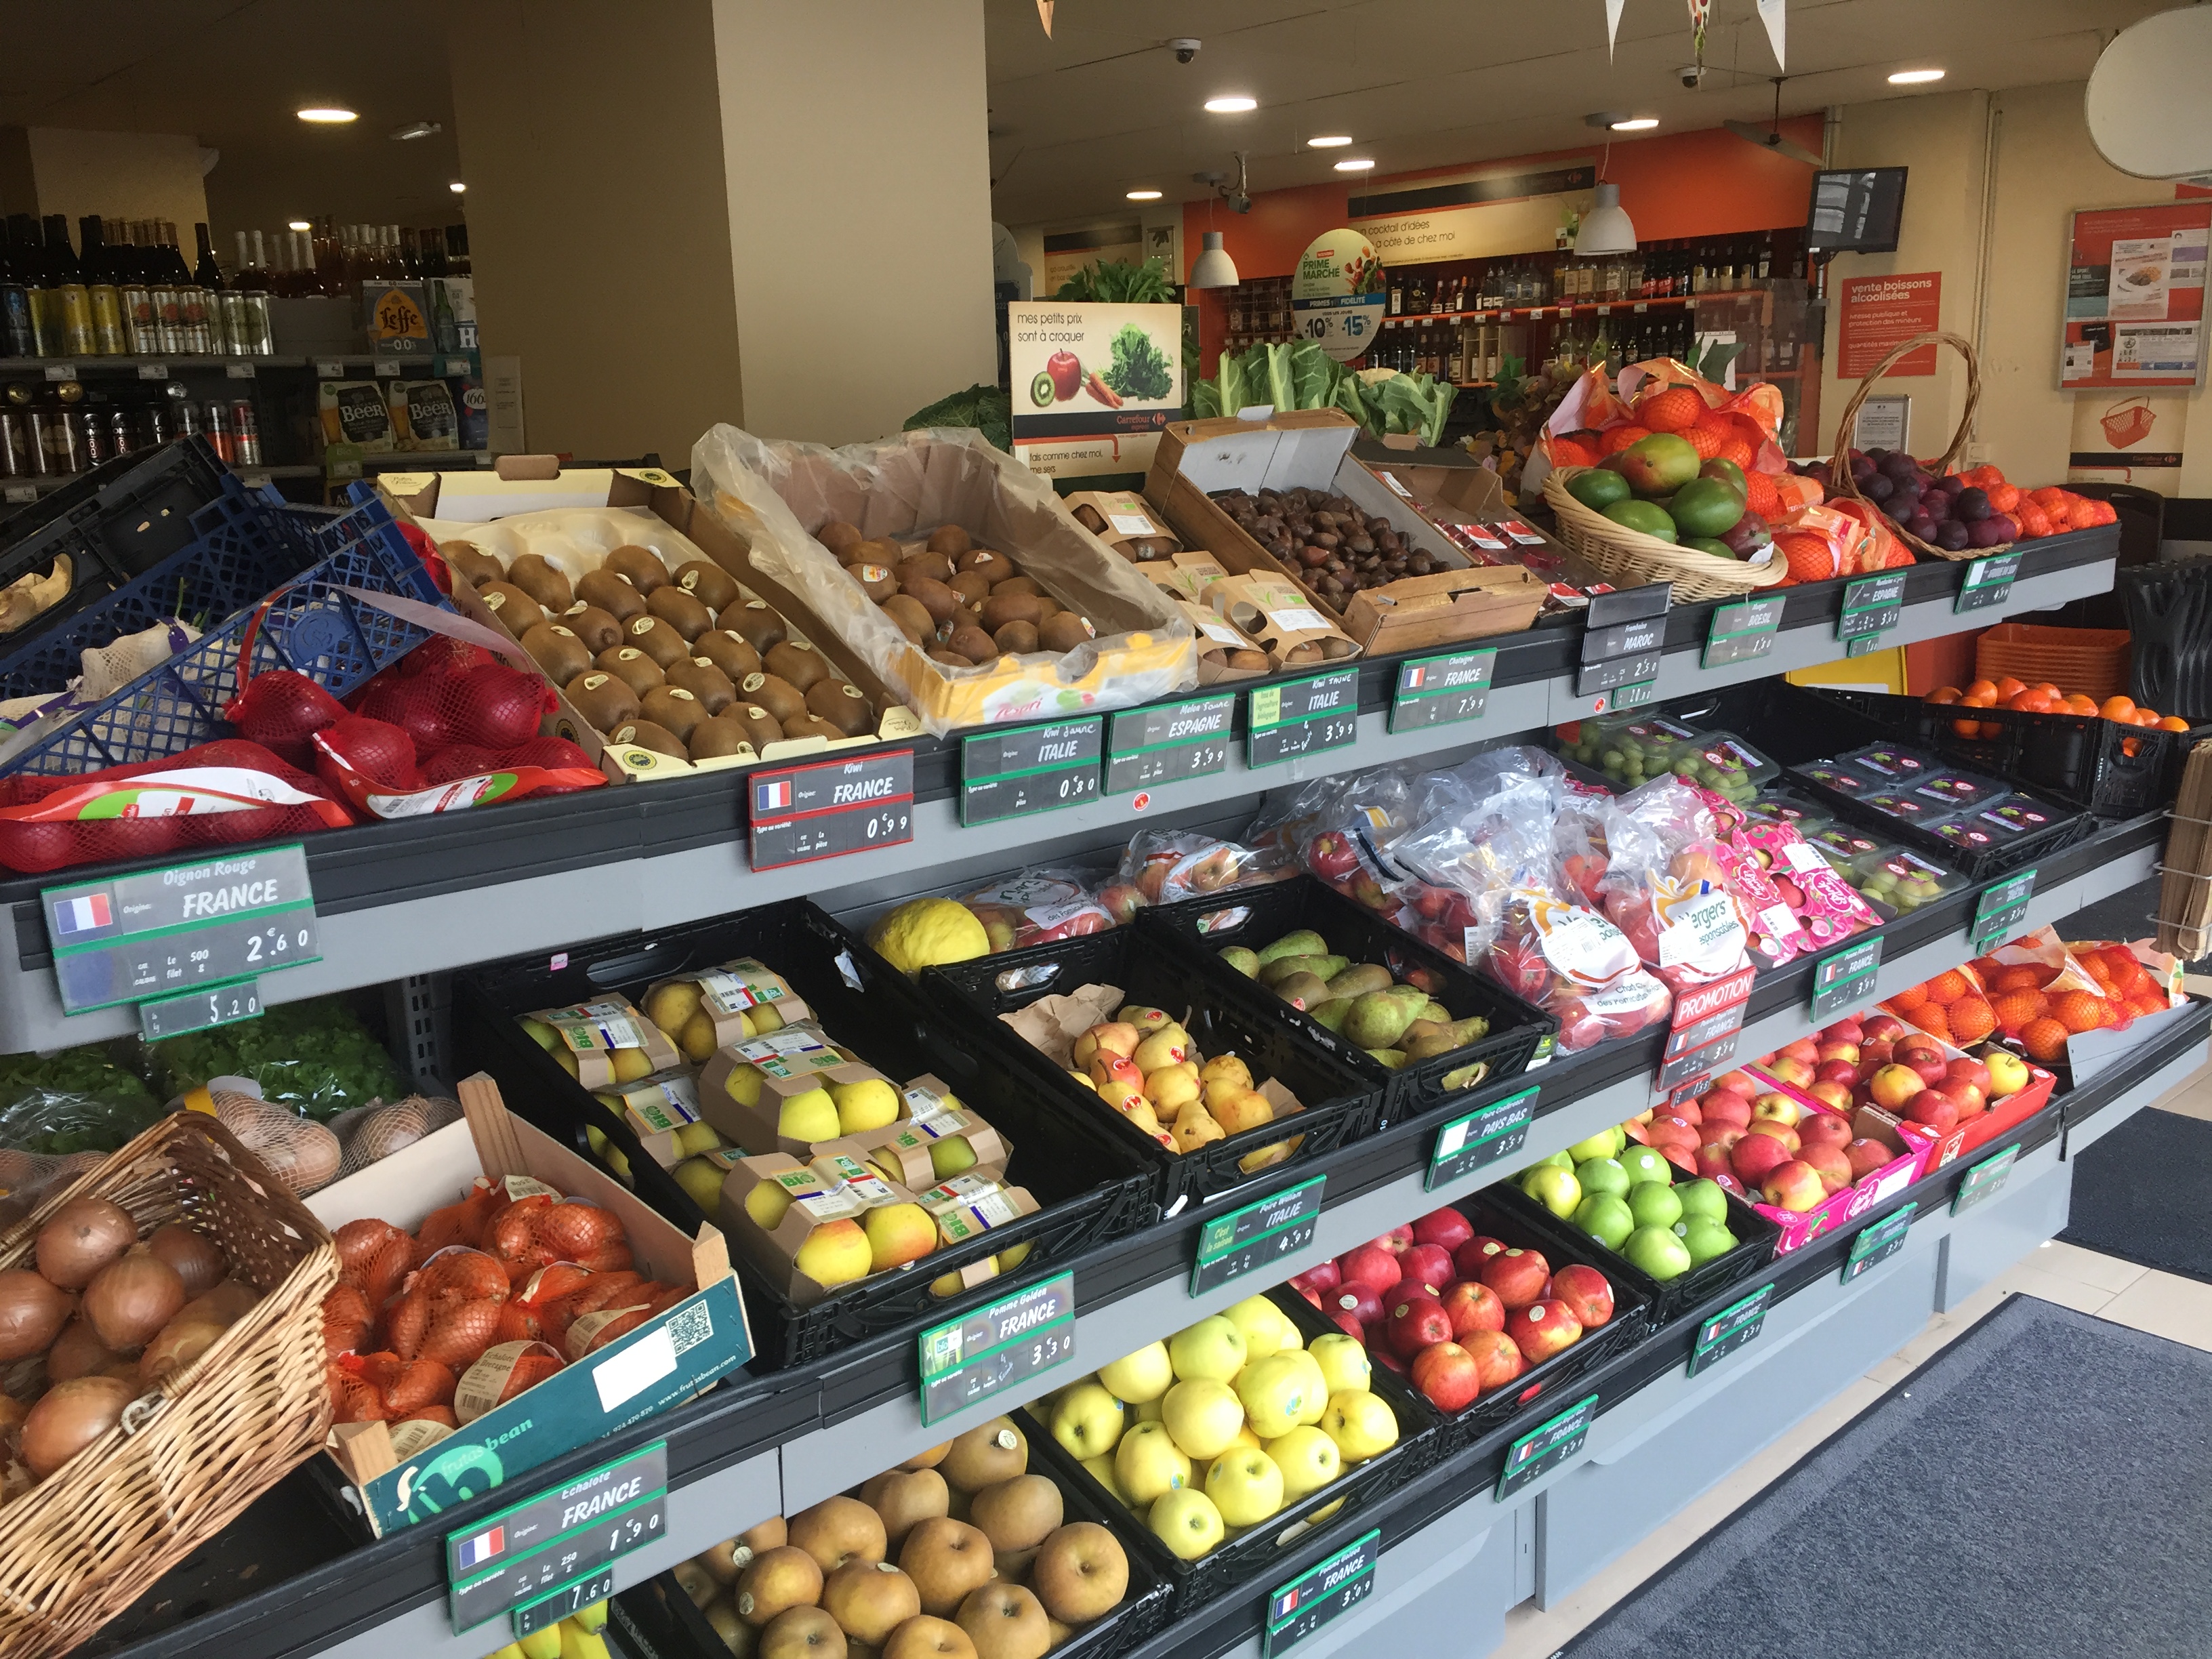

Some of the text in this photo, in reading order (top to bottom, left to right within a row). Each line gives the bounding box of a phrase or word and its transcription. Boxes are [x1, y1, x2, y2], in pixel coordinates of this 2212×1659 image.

[1368, 220, 1429, 236] cocktail d'idées
[1382, 230, 1455, 248] côté de chez moi
[1303, 259, 1330, 270] PRIME
[1303, 266, 1340, 280] MARCHÉ
[1851, 280, 1932, 293] vente boissons
[1309, 299, 1330, 307] PRIMES
[1851, 290, 1910, 303] alcoolisées
[380, 305, 418, 334] Leffe
[1017, 312, 1082, 326] mes petits prix
[1018, 329, 1084, 344] sont à croquer
[1117, 415, 1149, 424] Carrefour
[1042, 451, 1069, 461] comme
[1071, 450, 1087, 459] chez
[1089, 449, 1103, 458] moi,
[1044, 465, 1056, 473] sers
[1872, 586, 1899, 602] ESPAGNE
[1747, 611, 1771, 627] BRESIL
[1624, 632, 1654, 651] MAROC
[1311, 674, 1351, 690] Kiwi JAUNE
[1444, 668, 1482, 687] FRANCE
[1179, 704, 1201, 715] Melon
[1308, 690, 1340, 712] ITALIE
[1168, 714, 1223, 738] ESPAGNE
[1038, 739, 1078, 763] ITALIE
[844, 761, 863, 775] Kiwi
[834, 777, 894, 804] FRANCE
[756, 825, 768, 834] Type
[163, 859, 256, 886] Oignon Rouge
[182, 879, 278, 918] FRANCE
[190, 949, 209, 962] 500
[1849, 954, 1874, 974] FRANCE
[167, 968, 182, 980] filet
[1679, 973, 1753, 1021] PROMOTION
[1704, 1017, 1735, 1039] FRANCE
[1481, 1108, 1527, 1137] PAYS BAS
[1259, 1201, 1277, 1214] Poire
[1266, 1202, 1303, 1228] ITALIE
[1213, 1235, 1233, 1249] saison
[989, 1288, 1046, 1319] Pomme Golden
[1000, 1299, 1056, 1338] FRANCE
[485, 1351, 514, 1362] Echalote
[480, 1360, 511, 1372] Bretagne
[1549, 1416, 1584, 1444] FRANCE
[442, 1419, 533, 1476] frutas bean
[561, 1471, 611, 1500] Echalote
[514, 1476, 642, 1539] Origine: FRANCE
[543, 1565, 551, 1573] Le
[561, 1551, 577, 1566] 250
[459, 1568, 506, 1595] Type ou variété:
[541, 1573, 554, 1585] filet
[1324, 1555, 1365, 1591] FRANCE
